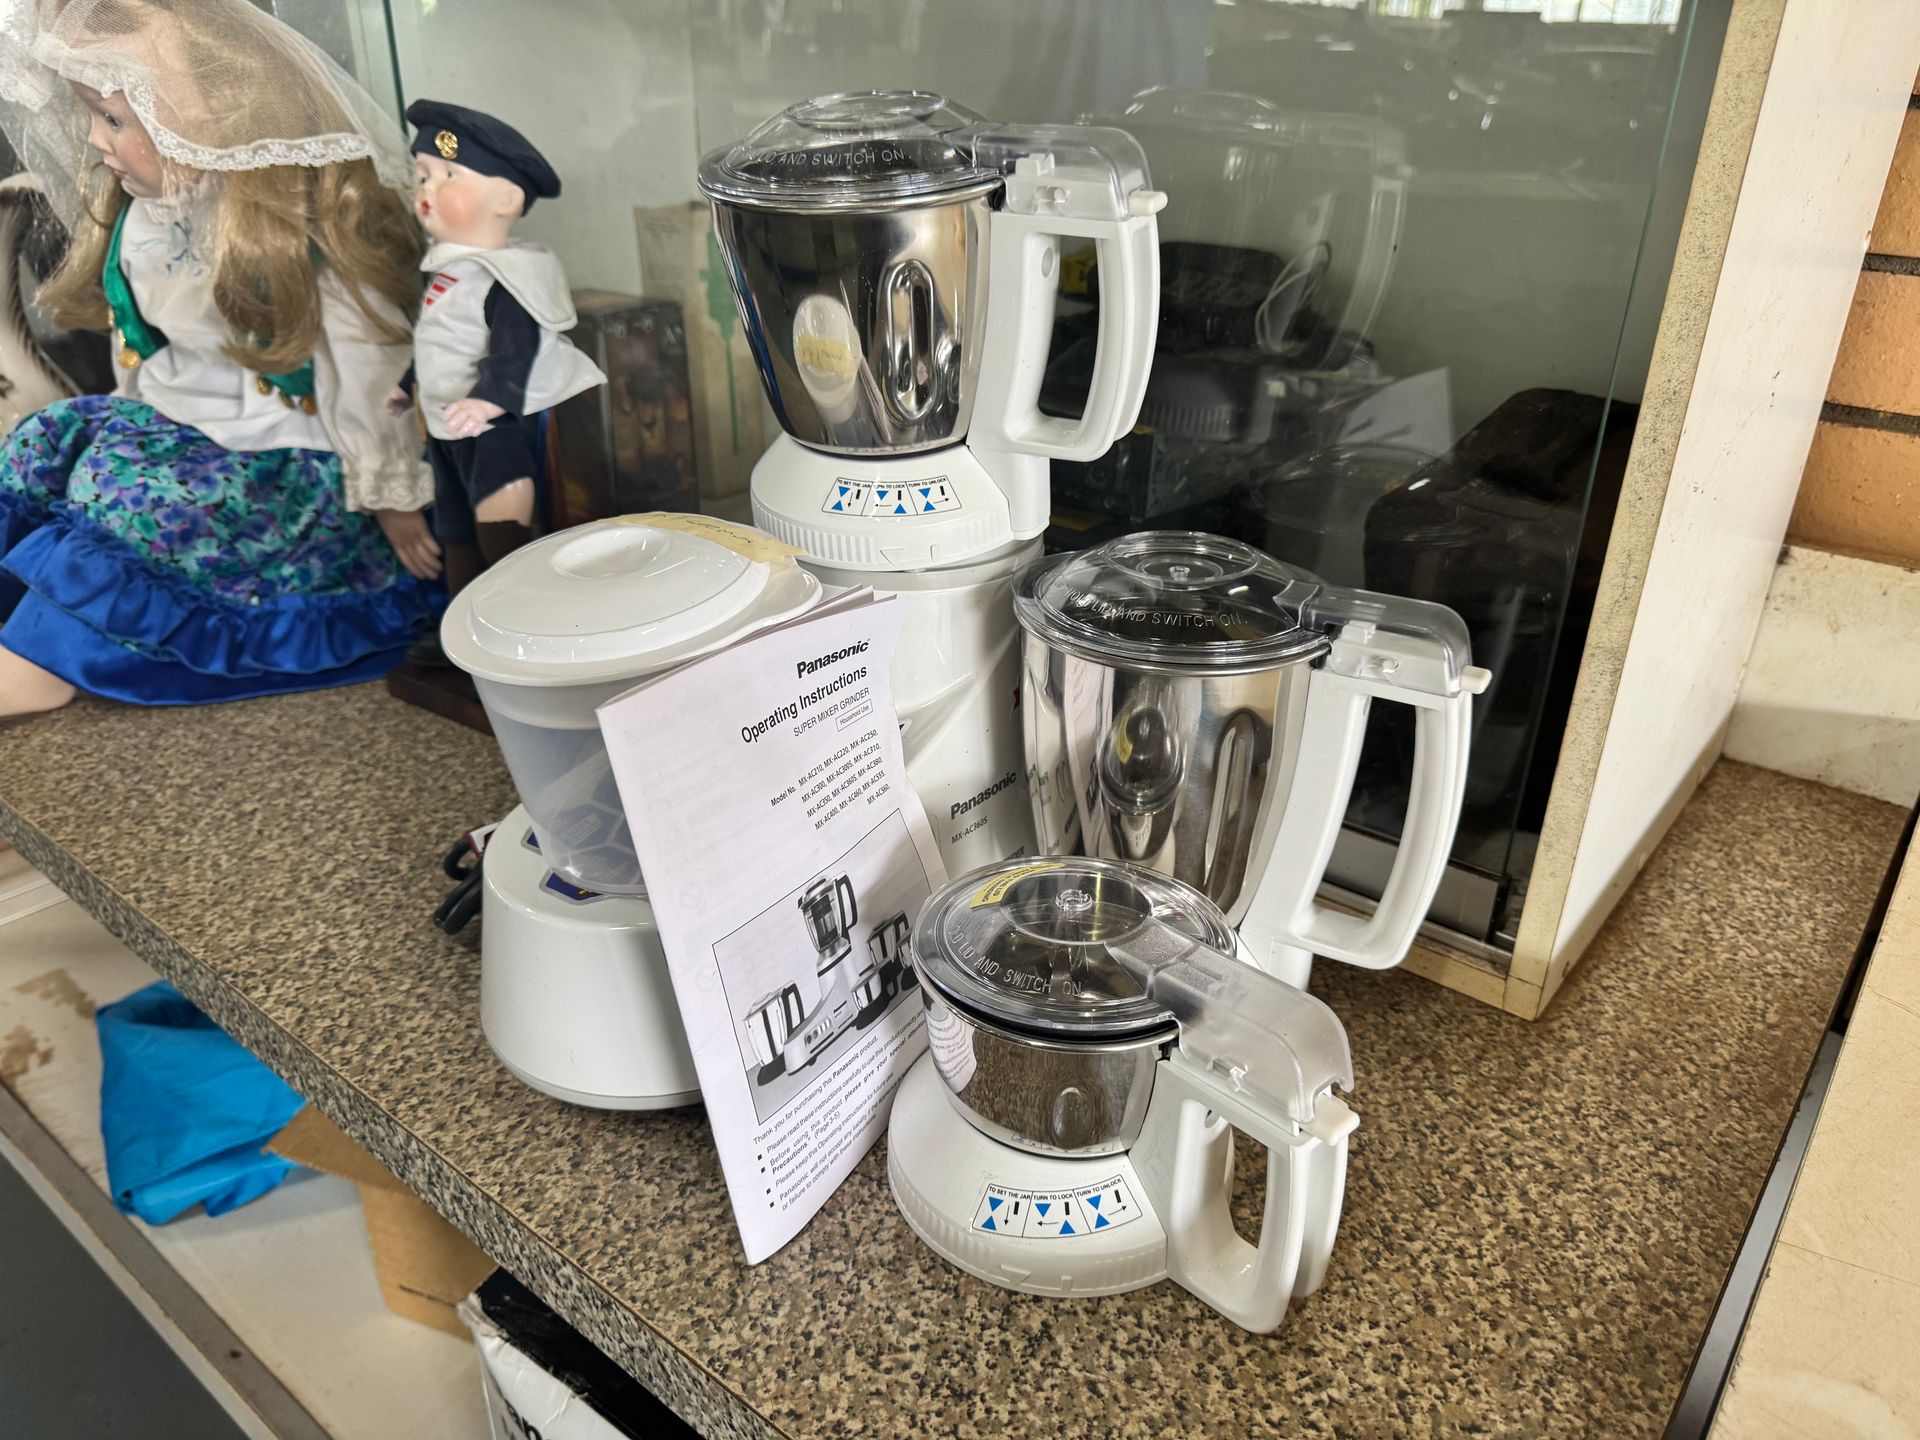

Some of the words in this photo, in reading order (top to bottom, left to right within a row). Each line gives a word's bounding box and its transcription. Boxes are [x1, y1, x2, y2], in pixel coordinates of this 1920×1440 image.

[777, 152, 807, 165] AND
[811, 151, 876, 166] SWITCH
[1116, 605, 1147, 622] AND
[1152, 612, 1215, 628] SWITCH
[796, 640, 869, 679] Panasonic
[741, 701, 798, 744] Operating
[799, 666, 868, 710] Instructions
[793, 717, 818, 737] SUPER
[817, 704, 840, 722] MIXER
[840, 687, 870, 710] GRINDER
[840, 710, 861, 726] Household
[860, 704, 870, 714] Use
[770, 790, 787, 807] Model
[786, 786, 797, 796] No.
[798, 764, 824, 787] MX-AC210,
[950, 772, 1017, 820] Panasonic
[958, 941, 976, 959] LID
[974, 956, 1000, 976] AND
[1003, 969, 1052, 994] SWITCH
[752, 1127, 774, 1145] Thank
[774, 1118, 785, 1132] you
[785, 1110, 793, 1120] for
[794, 1086, 823, 1115] purchasing
[822, 1076, 832, 1088] this
[832, 1052, 860, 1079] Panasonic
[766, 1134, 787, 1154] Please
[786, 1122, 800, 1137] read
[799, 1110, 814, 1126] these
[814, 1086, 842, 1114] instructions
[842, 1068, 862, 1088] carefully
[862, 1062, 868, 1070] to
[866, 1054, 876, 1066] use
[770, 1147, 790, 1166] Before
[792, 1130, 808, 1148] using
[810, 1120, 821, 1132] this
[822, 1098, 843, 1121] product
[844, 1081, 862, 1102] please
[814, 1121, 830, 1139] (Page
[775, 1168, 796, 1188] Please
[795, 1155, 809, 1170] keep
[808, 1146, 818, 1158] this
[818, 1124, 842, 1149] Operating
[780, 1172, 809, 1201] Panasonic
[989, 1185, 997, 1193] TO
[997, 1188, 1008, 1196] SET
[1008, 1191, 1019, 1199] THE
[1058, 1192, 1074, 1200] LOCK
[1076, 1188, 1092, 1198] TURN
[1092, 1186, 1100, 1194] TO
[1100, 1178, 1122, 1191] UNLOCK
